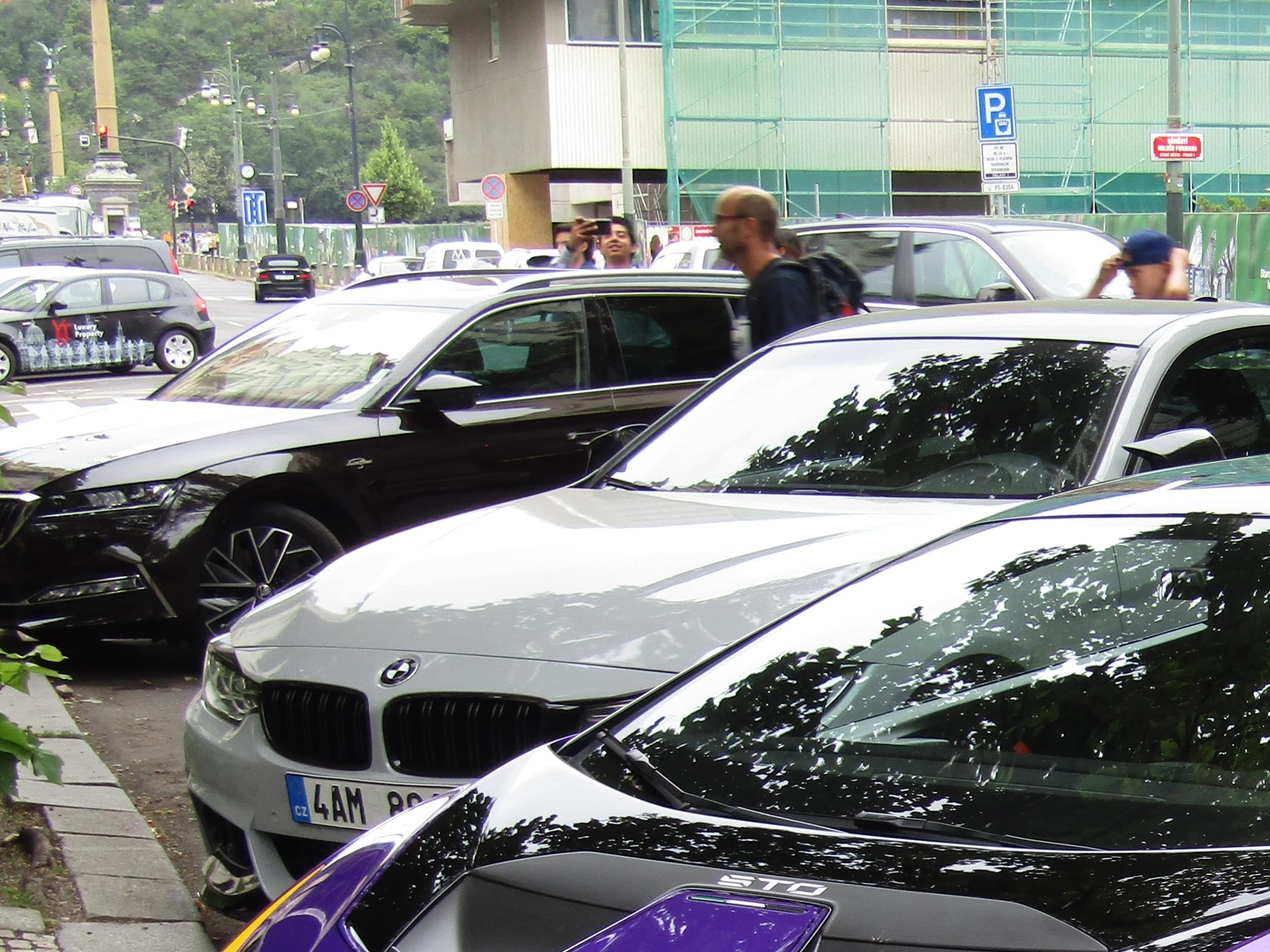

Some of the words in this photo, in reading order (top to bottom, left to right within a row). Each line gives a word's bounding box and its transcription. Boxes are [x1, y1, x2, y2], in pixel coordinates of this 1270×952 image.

[984, 92, 1006, 124] P
[75, 330, 104, 338] Property
[295, 806, 309, 817] CZ
[314, 784, 367, 825] 4AM
[718, 875, 828, 896] STO
